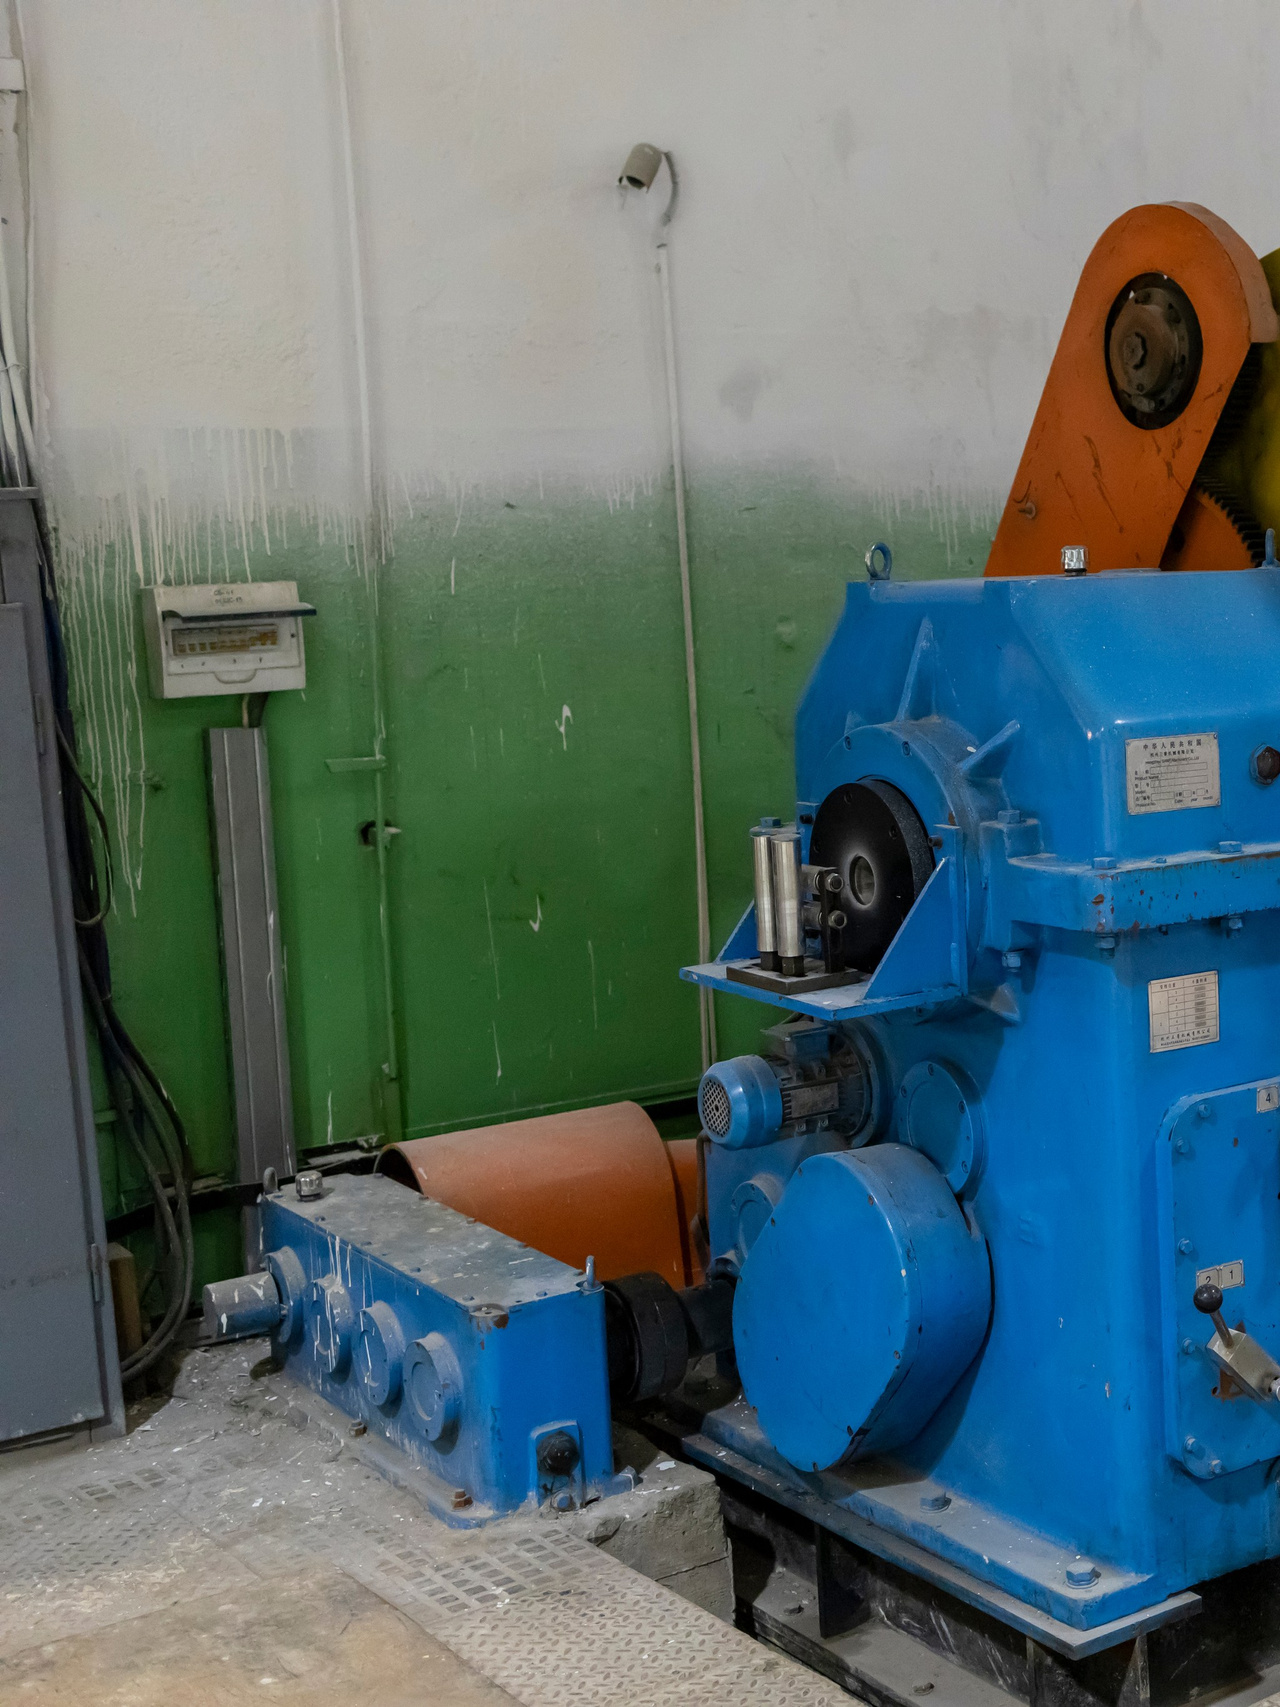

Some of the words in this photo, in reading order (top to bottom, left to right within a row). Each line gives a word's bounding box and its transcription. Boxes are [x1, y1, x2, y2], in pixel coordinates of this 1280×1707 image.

[1143, 739, 1202, 751] 中华人民共和国
[1265, 1093, 1271, 1104] 4
[1229, 1269, 1234, 1280] 1
